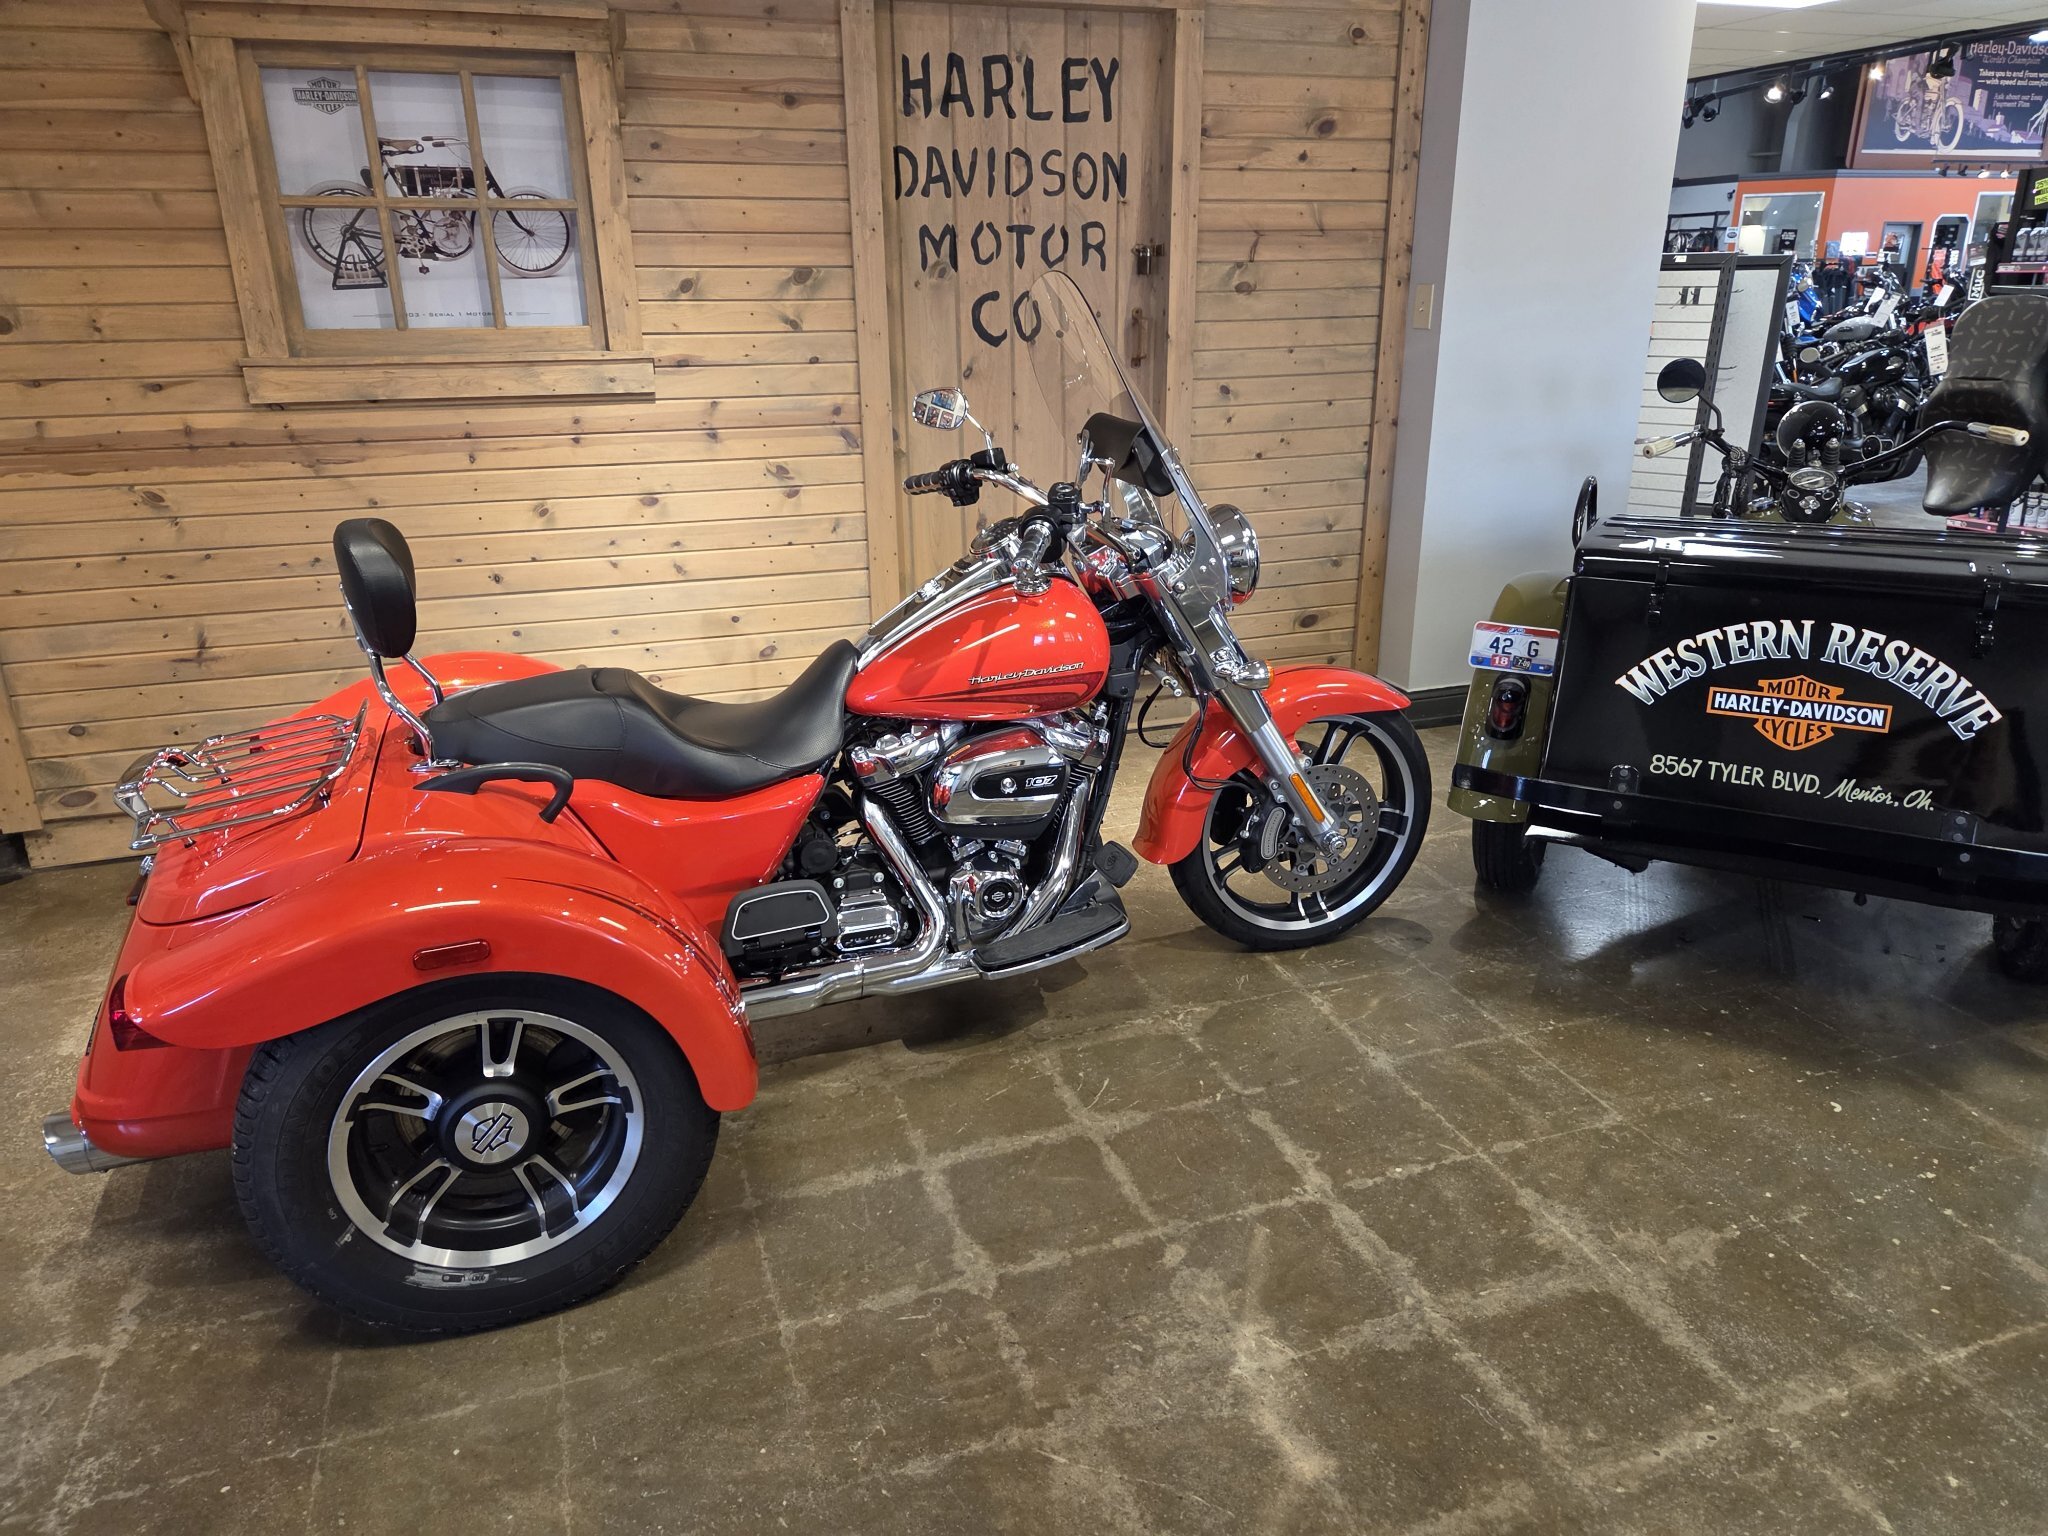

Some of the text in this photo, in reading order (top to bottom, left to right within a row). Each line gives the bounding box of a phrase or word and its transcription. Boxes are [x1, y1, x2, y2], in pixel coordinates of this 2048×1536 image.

[311, 80, 337, 88] MOTOR
[2000, 78, 2017, 86] speed
[2024, 70, 2038, 78] from
[295, 90, 357, 101] HARLEY-DAVIDSON
[902, 52, 1119, 122] HARLEY
[316, 103, 341, 112] CYCLES
[893, 146, 1127, 202] DAVIDSON
[918, 221, 1107, 272] MOTOR
[971, 291, 1042, 347] CO
[1489, 637, 1540, 658] 42 G
[1494, 656, 1508, 665] 18
[968, 662, 1085, 684] Harley-Davidson
[1615, 619, 2002, 740] WESTERN RESERVE
[1766, 679, 1831, 699] MOTOR
[1713, 692, 1885, 727] HARLEY-DAVIDSON
[1761, 717, 1828, 746] CYCLES
[1025, 774, 1058, 787] 107
[1649, 754, 1935, 812] 8567 TYLER BLVD. Mentor, Oh.
